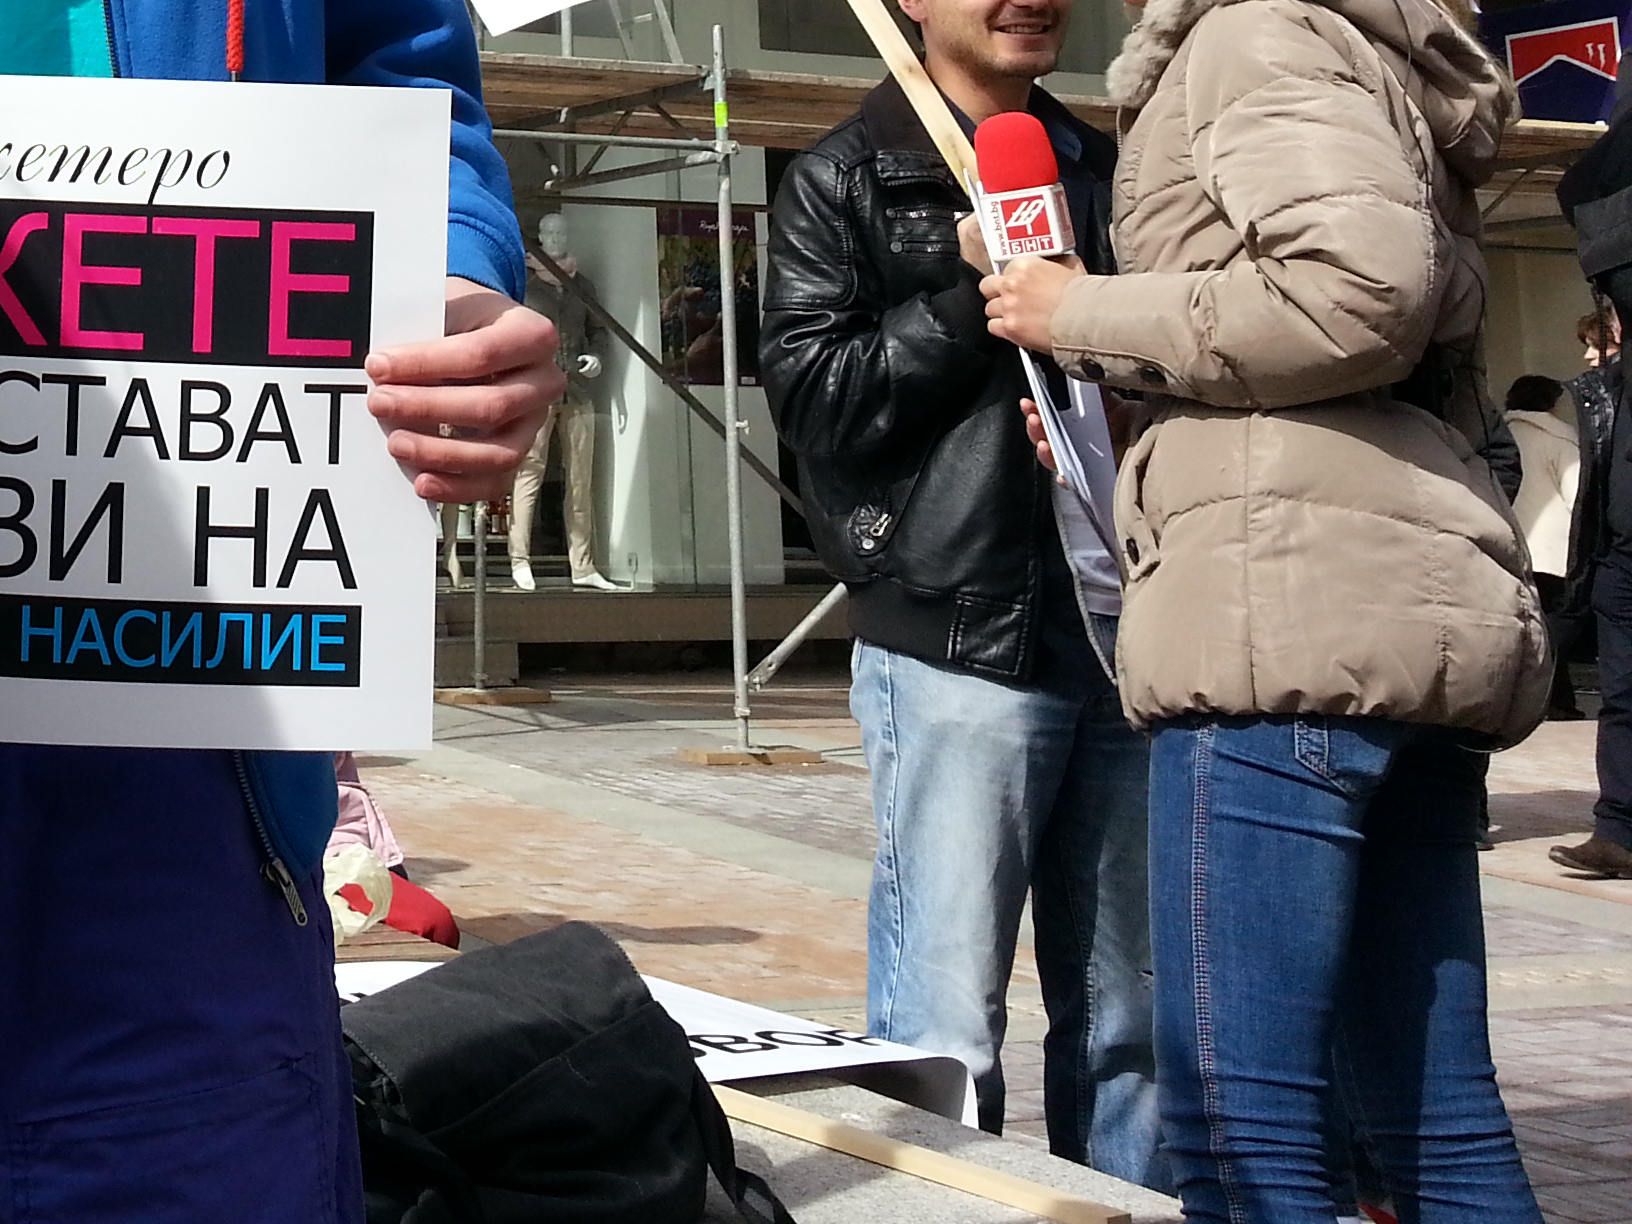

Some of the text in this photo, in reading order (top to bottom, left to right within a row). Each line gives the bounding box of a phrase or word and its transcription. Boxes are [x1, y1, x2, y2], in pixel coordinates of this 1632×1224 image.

[1009, 236, 1055, 255] БНТ
[194, 487, 358, 591] НА
[20, 605, 347, 674] НАСИЛИЕ
